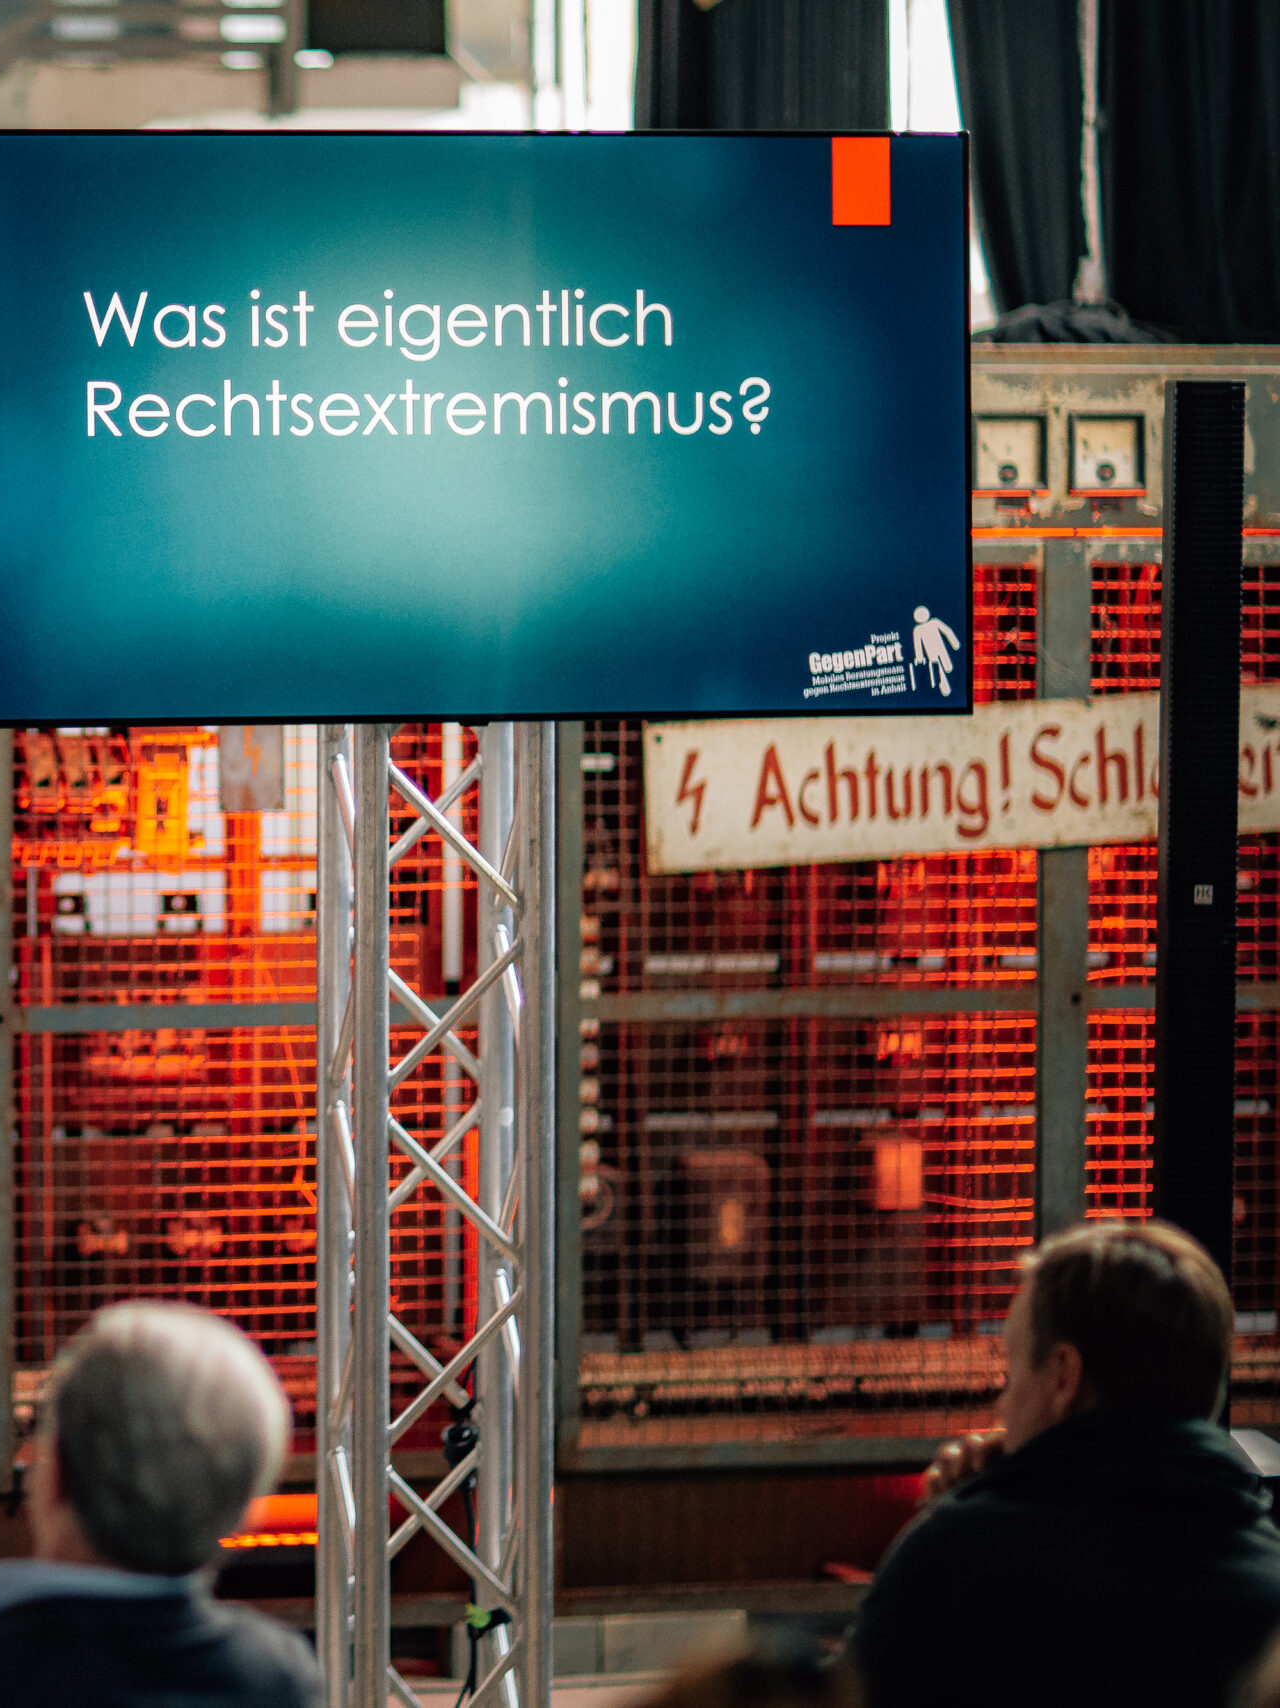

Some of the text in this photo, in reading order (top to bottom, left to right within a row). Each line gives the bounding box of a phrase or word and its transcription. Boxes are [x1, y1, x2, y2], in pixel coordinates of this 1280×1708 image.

[83, 289, 673, 361] Was ist eigentlich
[85, 377, 771, 437] Rechtsextremismus?
[870, 631, 899, 644] Projekt
[809, 642, 904, 674] GegenPart
[803, 686, 829, 698] gegen
[871, 683, 906, 696] in Anhalt
[750, 730, 1012, 838] Achtung!
